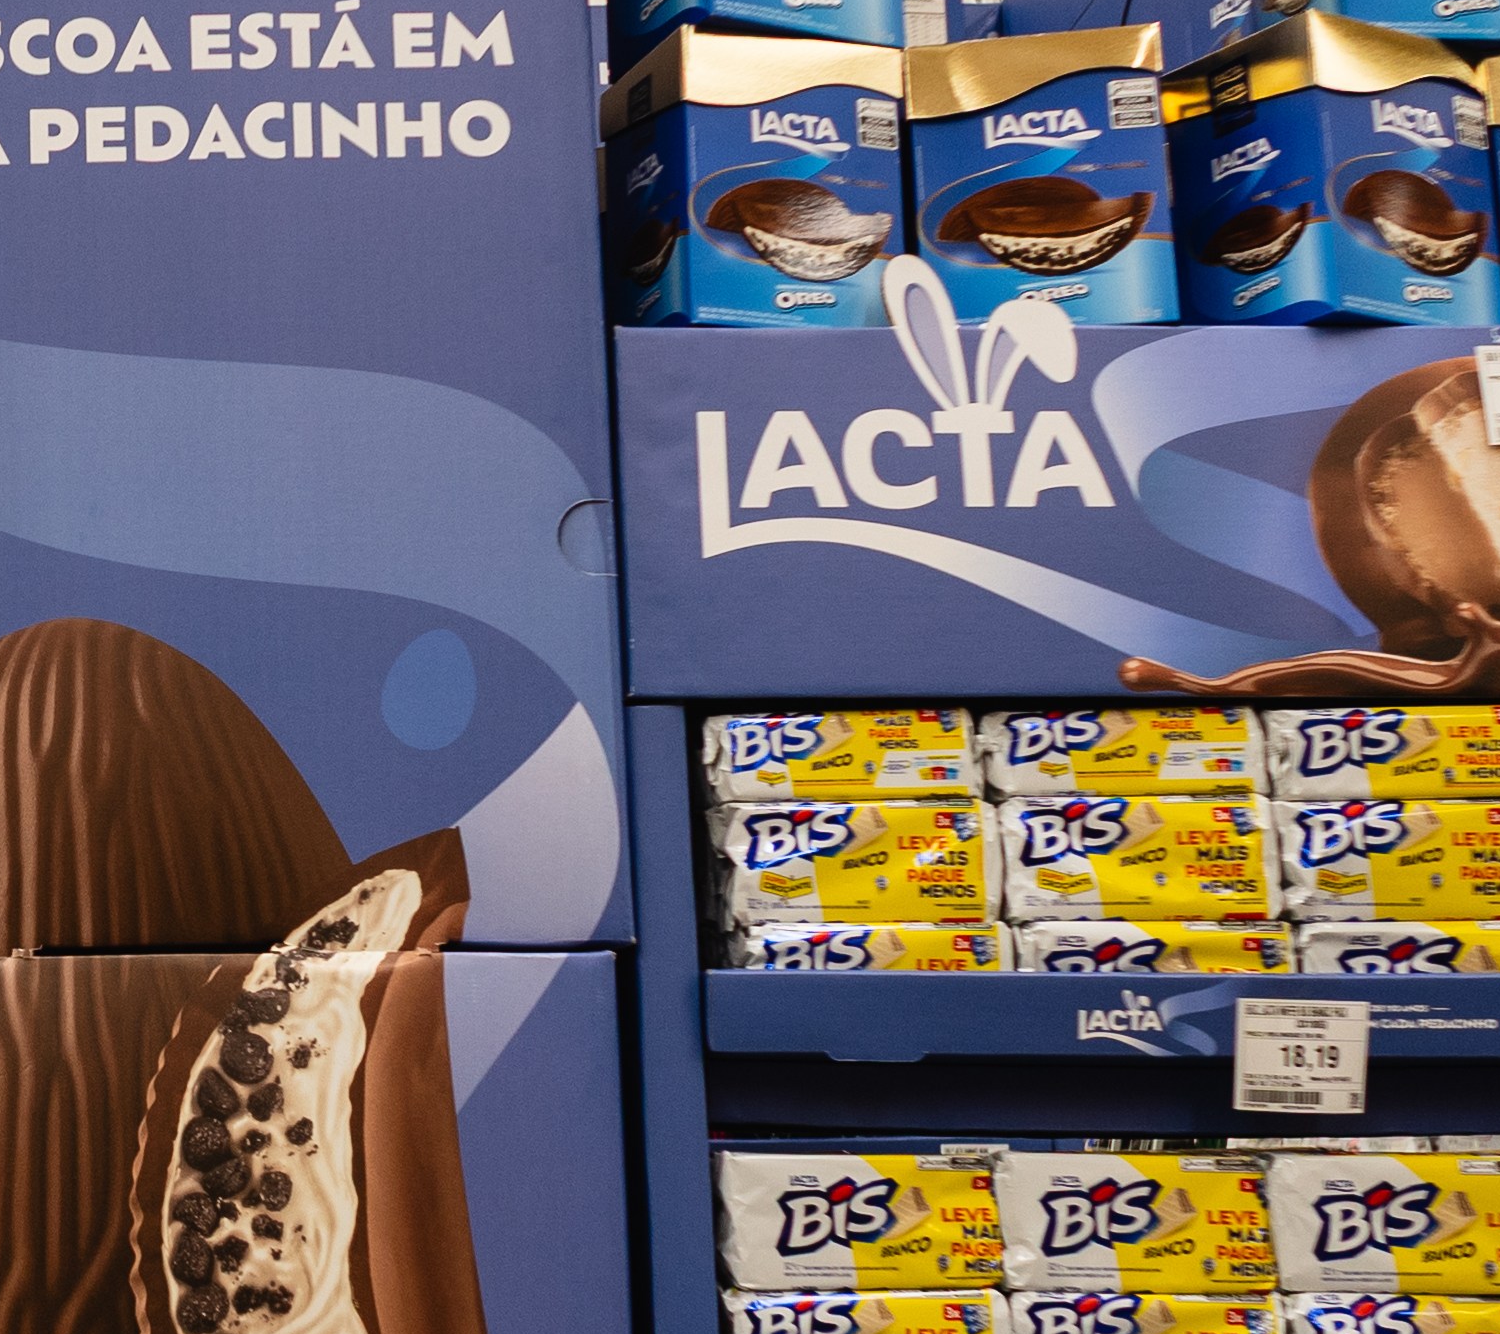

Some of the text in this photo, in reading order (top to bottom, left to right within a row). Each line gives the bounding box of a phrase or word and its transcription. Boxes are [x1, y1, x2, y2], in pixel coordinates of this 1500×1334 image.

[394, 9, 514, 68] EM
[29, 100, 511, 165] PEDACINHO
[751, 109, 845, 149] LACTA
[983, 108, 1094, 148] LACTA
[1371, 99, 1450, 147] LACTA
[694, 404, 1116, 560] LACTA
[1304, 709, 1402, 771] BIS
[1025, 803, 1125, 860] BIS
[1176, 831, 1229, 845] LEVE
[1195, 846, 1249, 861] MAIS
[1186, 865, 1244, 879] PAGUE
[1077, 1009, 1163, 1040] LACTA
[1279, 1044, 1341, 1072] 18,19
[786, 1182, 891, 1248] BIS
[1325, 1186, 1432, 1253] BIS
